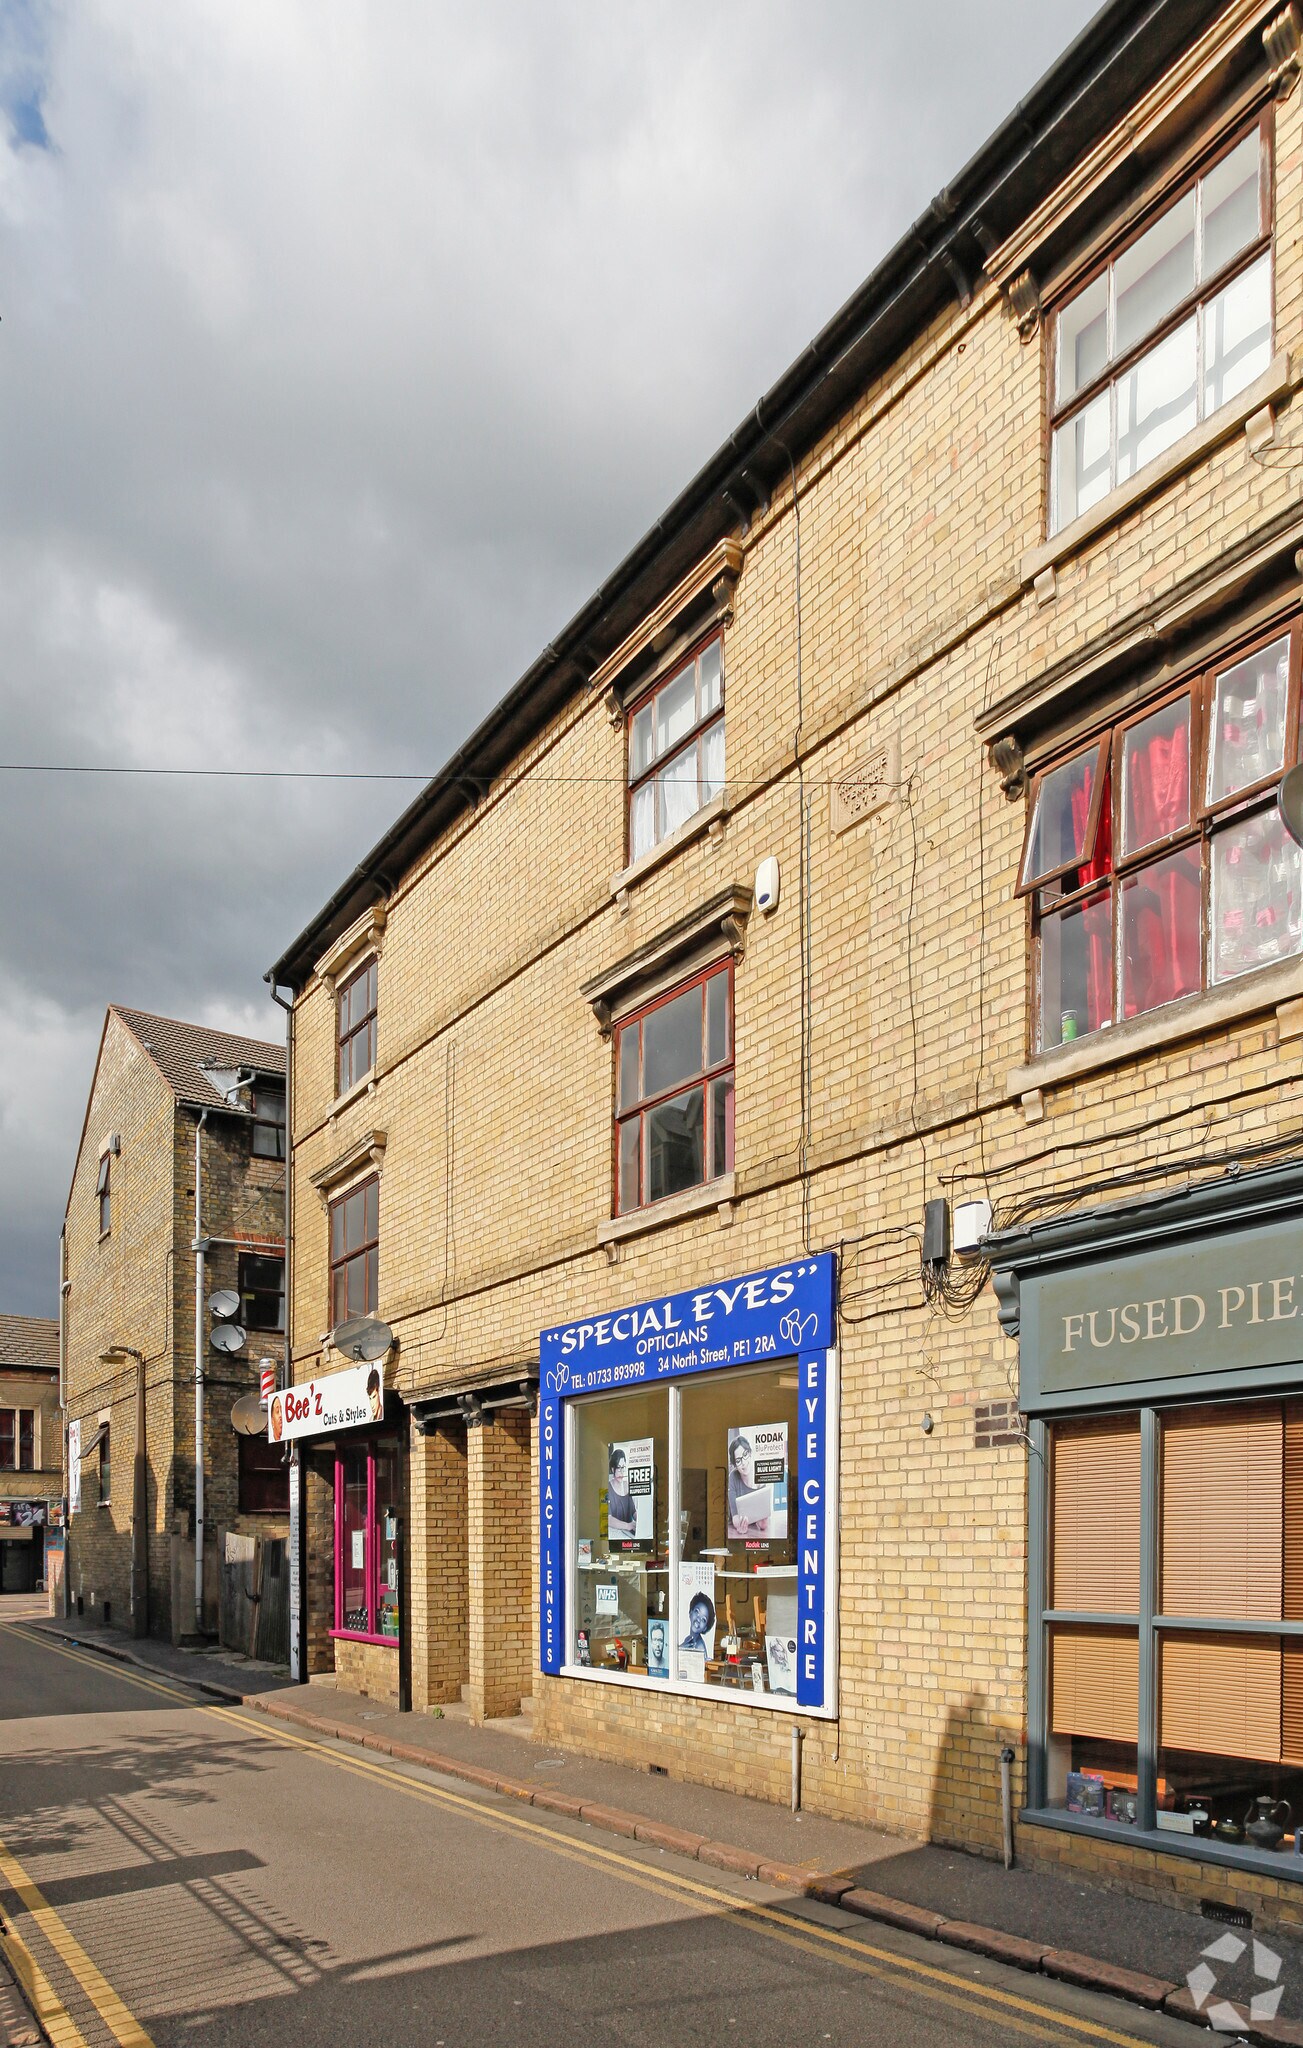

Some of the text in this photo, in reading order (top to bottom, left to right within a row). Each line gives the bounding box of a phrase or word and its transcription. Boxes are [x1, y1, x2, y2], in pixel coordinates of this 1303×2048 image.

[1061, 1273, 1303, 1353] FUSED PIE
[636, 1325, 708, 1356] OPTICIANS
[658, 1334, 777, 1373] 34 North Street, PE1 2RA
[571, 1362, 645, 1389] TEL: 01733 893998
[285, 1383, 322, 1422] Bee'z
[323, 1406, 366, 1427] Cuts & Styles
[755, 1432, 784, 1443] KODAK
[629, 1468, 650, 1483] FREE
[544, 1405, 554, 1663] CONTACT LENSES
[804, 1362, 820, 1679] EYE CENTRE
[599, 1589, 616, 1600] NHS
